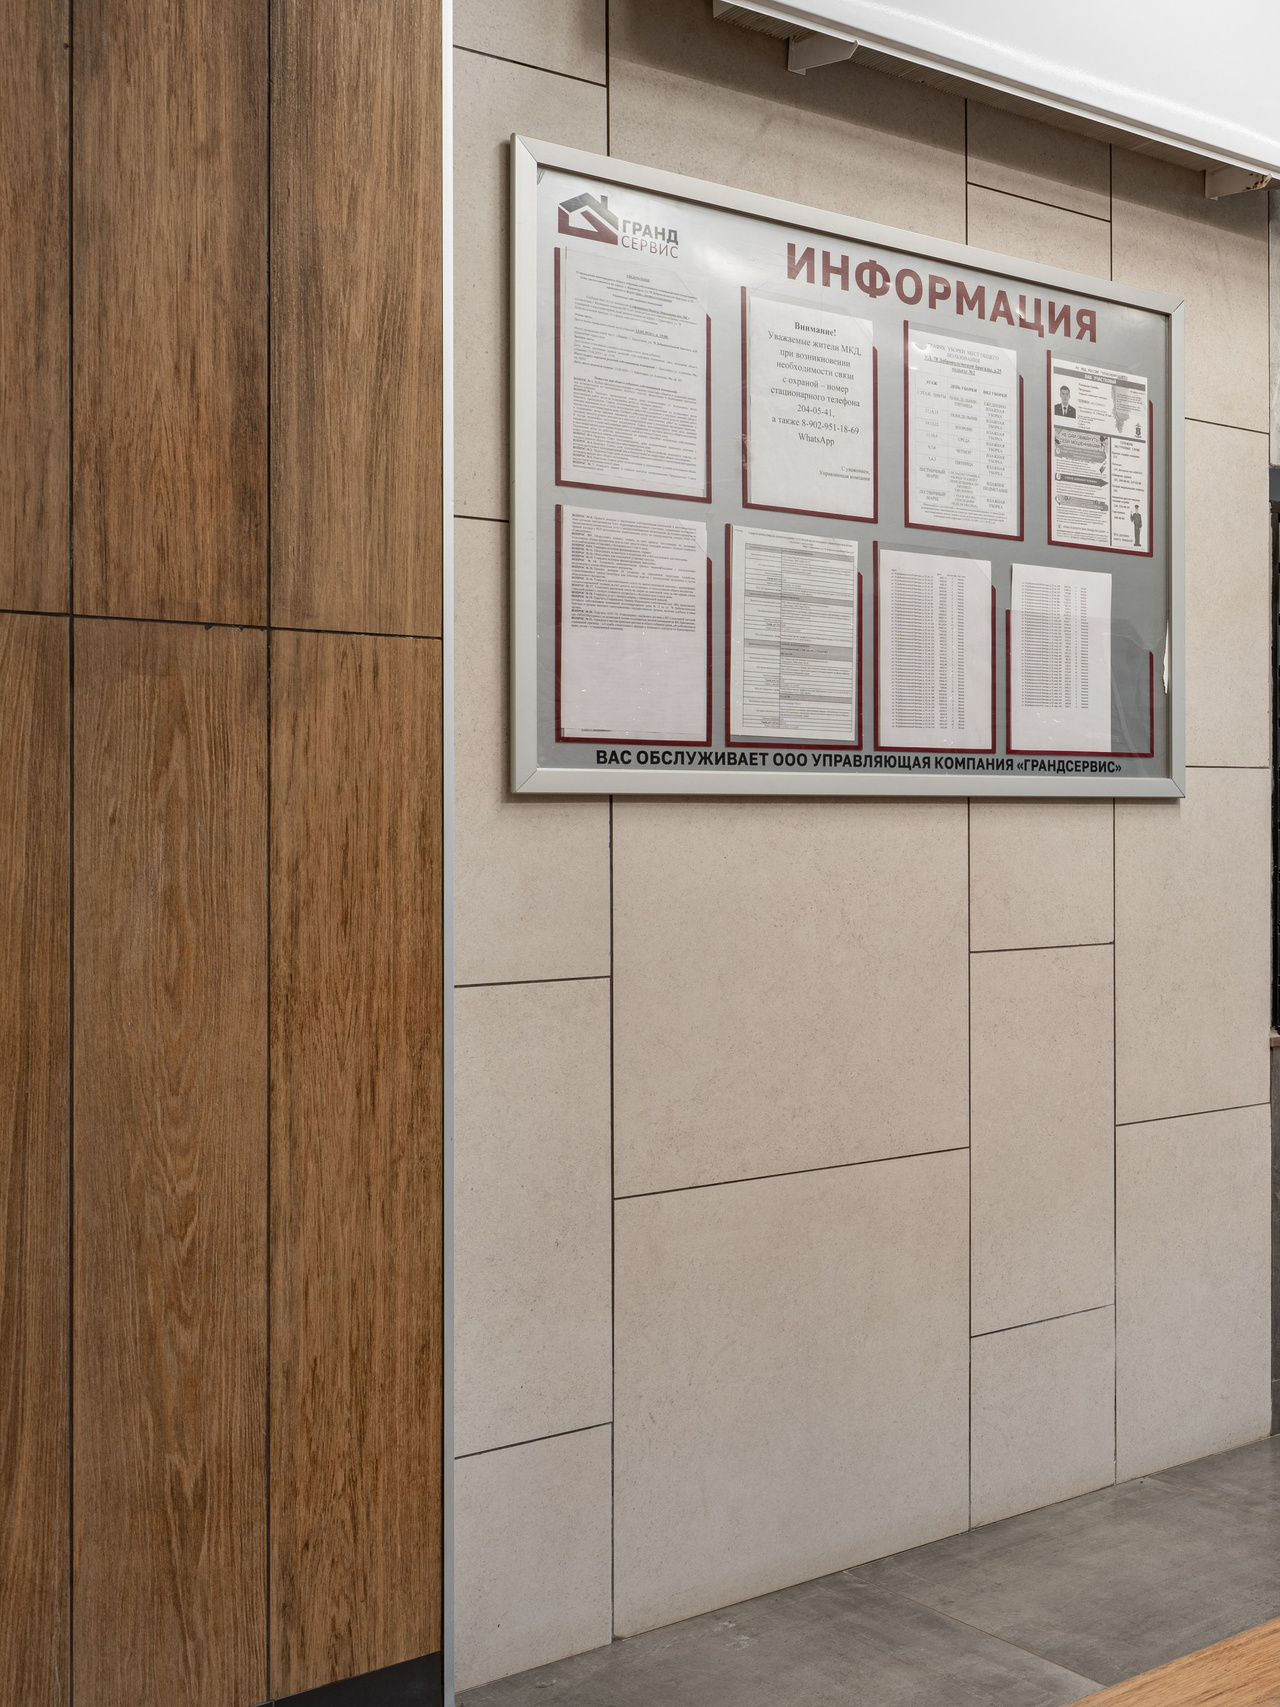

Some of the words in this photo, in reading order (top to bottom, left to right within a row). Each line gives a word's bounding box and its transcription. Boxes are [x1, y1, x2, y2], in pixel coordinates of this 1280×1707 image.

[622, 219, 679, 245] ГРАНД
[621, 235, 679, 259] СЕРВИС
[787, 242, 1097, 343] ИНФОРМАЦИЯ
[794, 321, 837, 337] Внимание!
[768, 331, 811, 347] Уважаемые
[813, 340, 840, 352] жители
[780, 349, 794, 358] при
[796, 351, 850, 367] возникновении
[776, 360, 833, 377] необходимости
[835, 371, 854, 380] связи
[788, 376, 819, 388] охраной
[827, 385, 849, 394] номер
[770, 387, 825, 402] стационарного
[827, 396, 860, 407] телефона
[778, 417, 800, 426] также
[798, 432, 835, 447] WhatsApp
[597, 750, 631, 764] ВАС
[637, 750, 769, 767] ОБСЛУЖИВАЕТ
[773, 753, 807, 766] ООО
[812, 753, 931, 770] УПРАВЛЯЮЩАЯ
[935, 757, 1013, 770] КОМПАНИЯ
[1017, 759, 1121, 774] «ГРАНДСЕРВИС»
